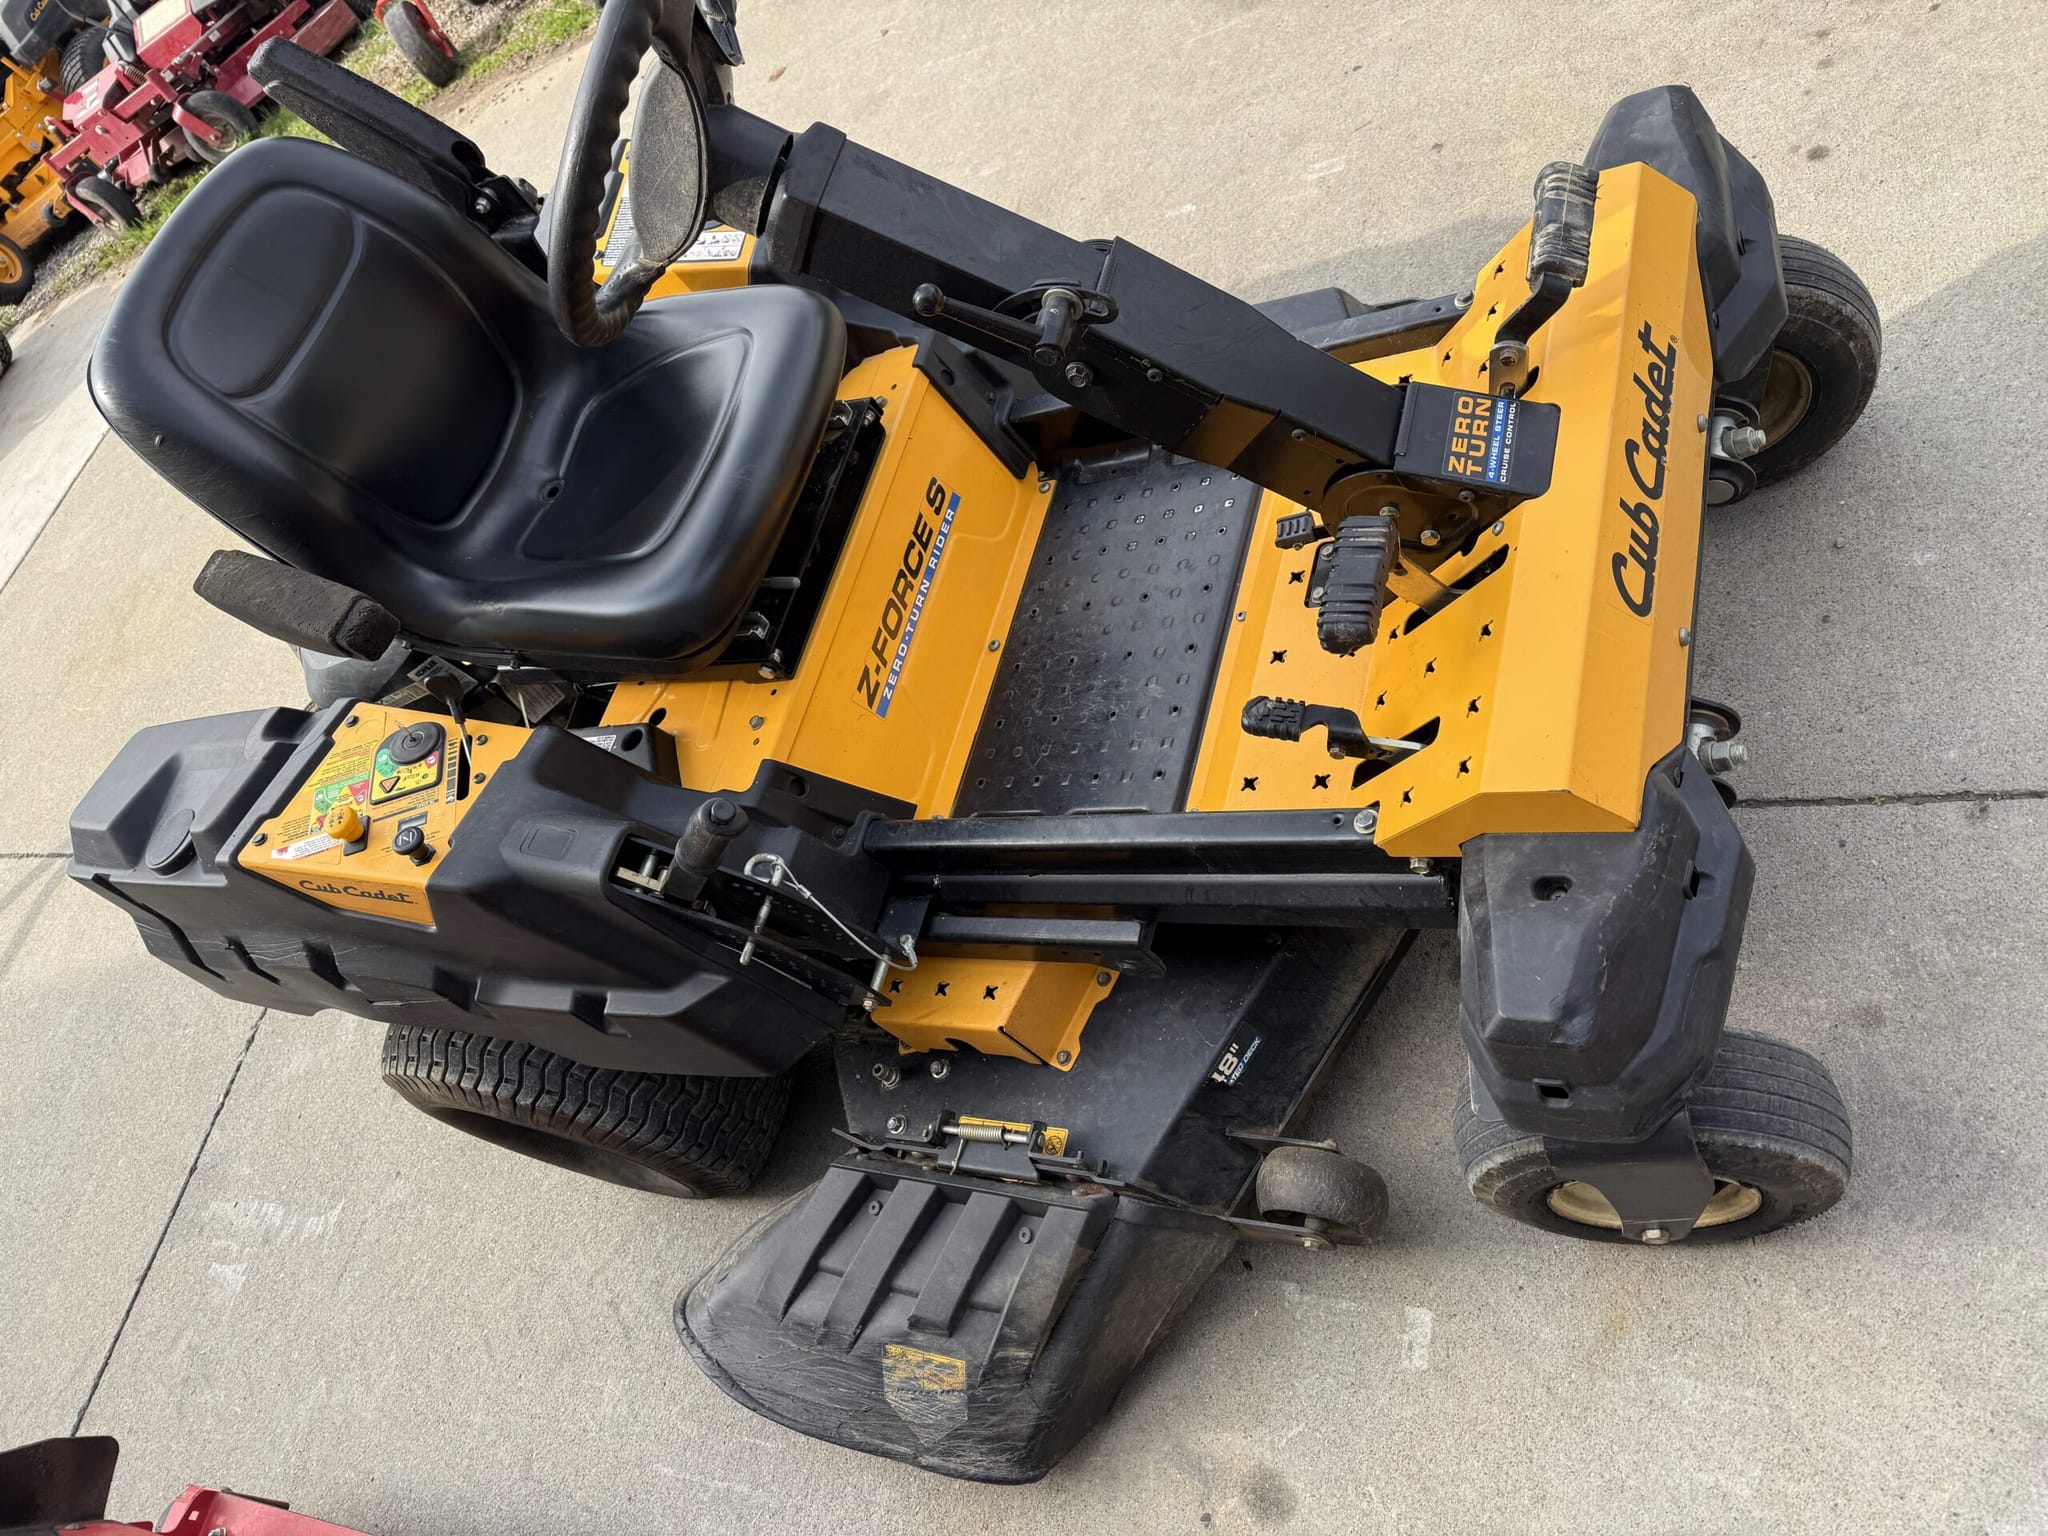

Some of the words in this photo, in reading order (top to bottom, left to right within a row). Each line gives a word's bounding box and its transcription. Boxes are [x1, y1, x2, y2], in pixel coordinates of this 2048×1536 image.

[1448, 396, 1474, 474] ZERO
[1465, 397, 1492, 476] TURN
[1494, 401, 1505, 432] STEER
[1499, 447, 1511, 483] CRUISE
[1505, 402, 1517, 445] CONTROL
[1624, 320, 1677, 500] Cadet
[1488, 435, 1501, 479] 4-WHEEL
[928, 508, 955, 570] RIDER
[1612, 497, 1660, 618] Cub
[857, 512, 934, 710] Z-FORCE
[926, 476, 947, 516] S
[298, 880, 342, 894] Cub
[342, 886, 414, 904] Cadet
[1243, 1036, 1261, 1063] DECK
